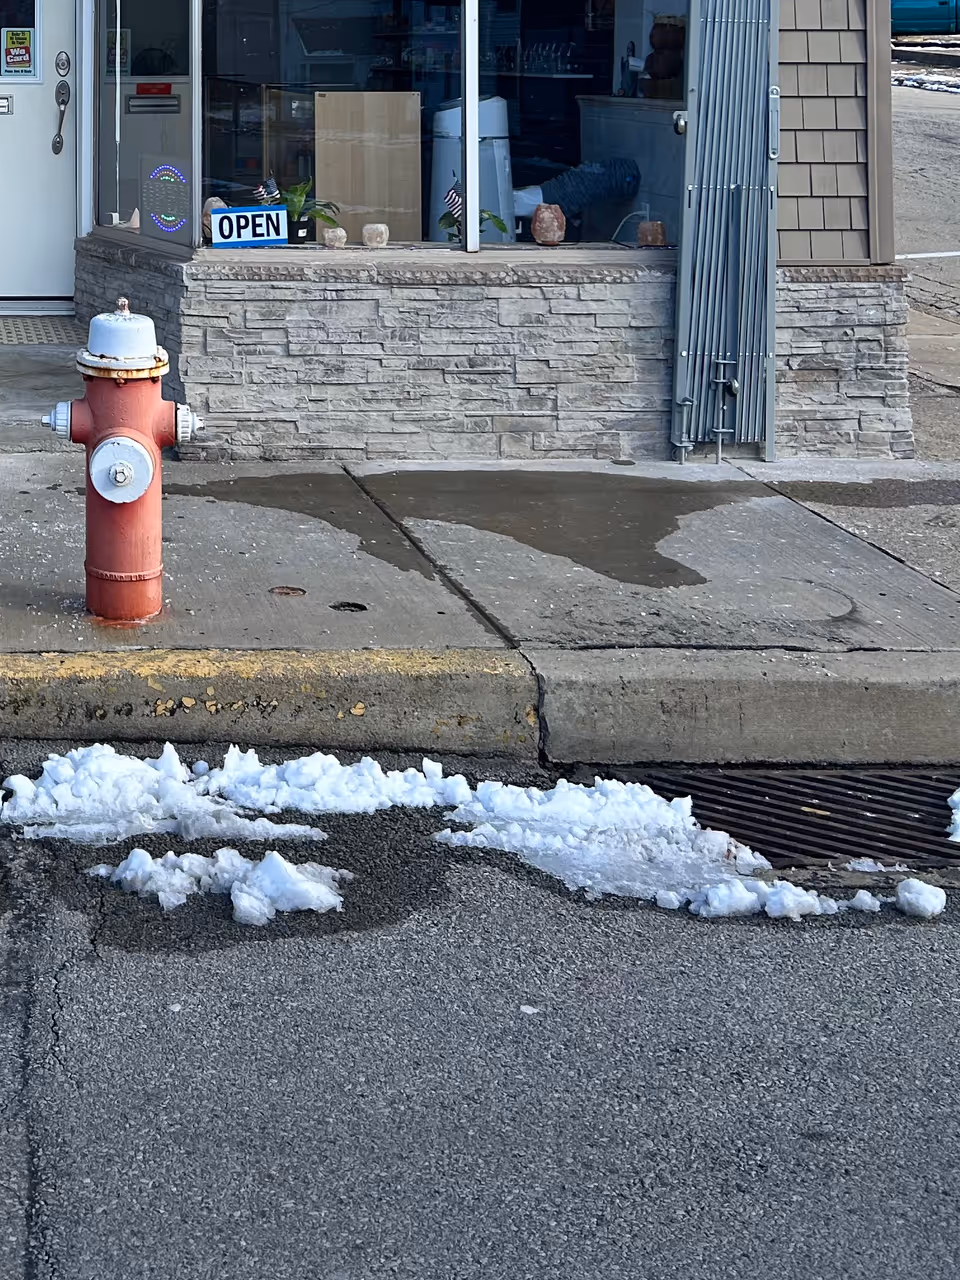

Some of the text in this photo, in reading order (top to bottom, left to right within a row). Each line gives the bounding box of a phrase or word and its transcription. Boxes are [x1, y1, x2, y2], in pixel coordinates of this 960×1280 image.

[10, 47, 26, 55] We
[6, 54, 30, 63] Card
[218, 212, 281, 240] OPEN
